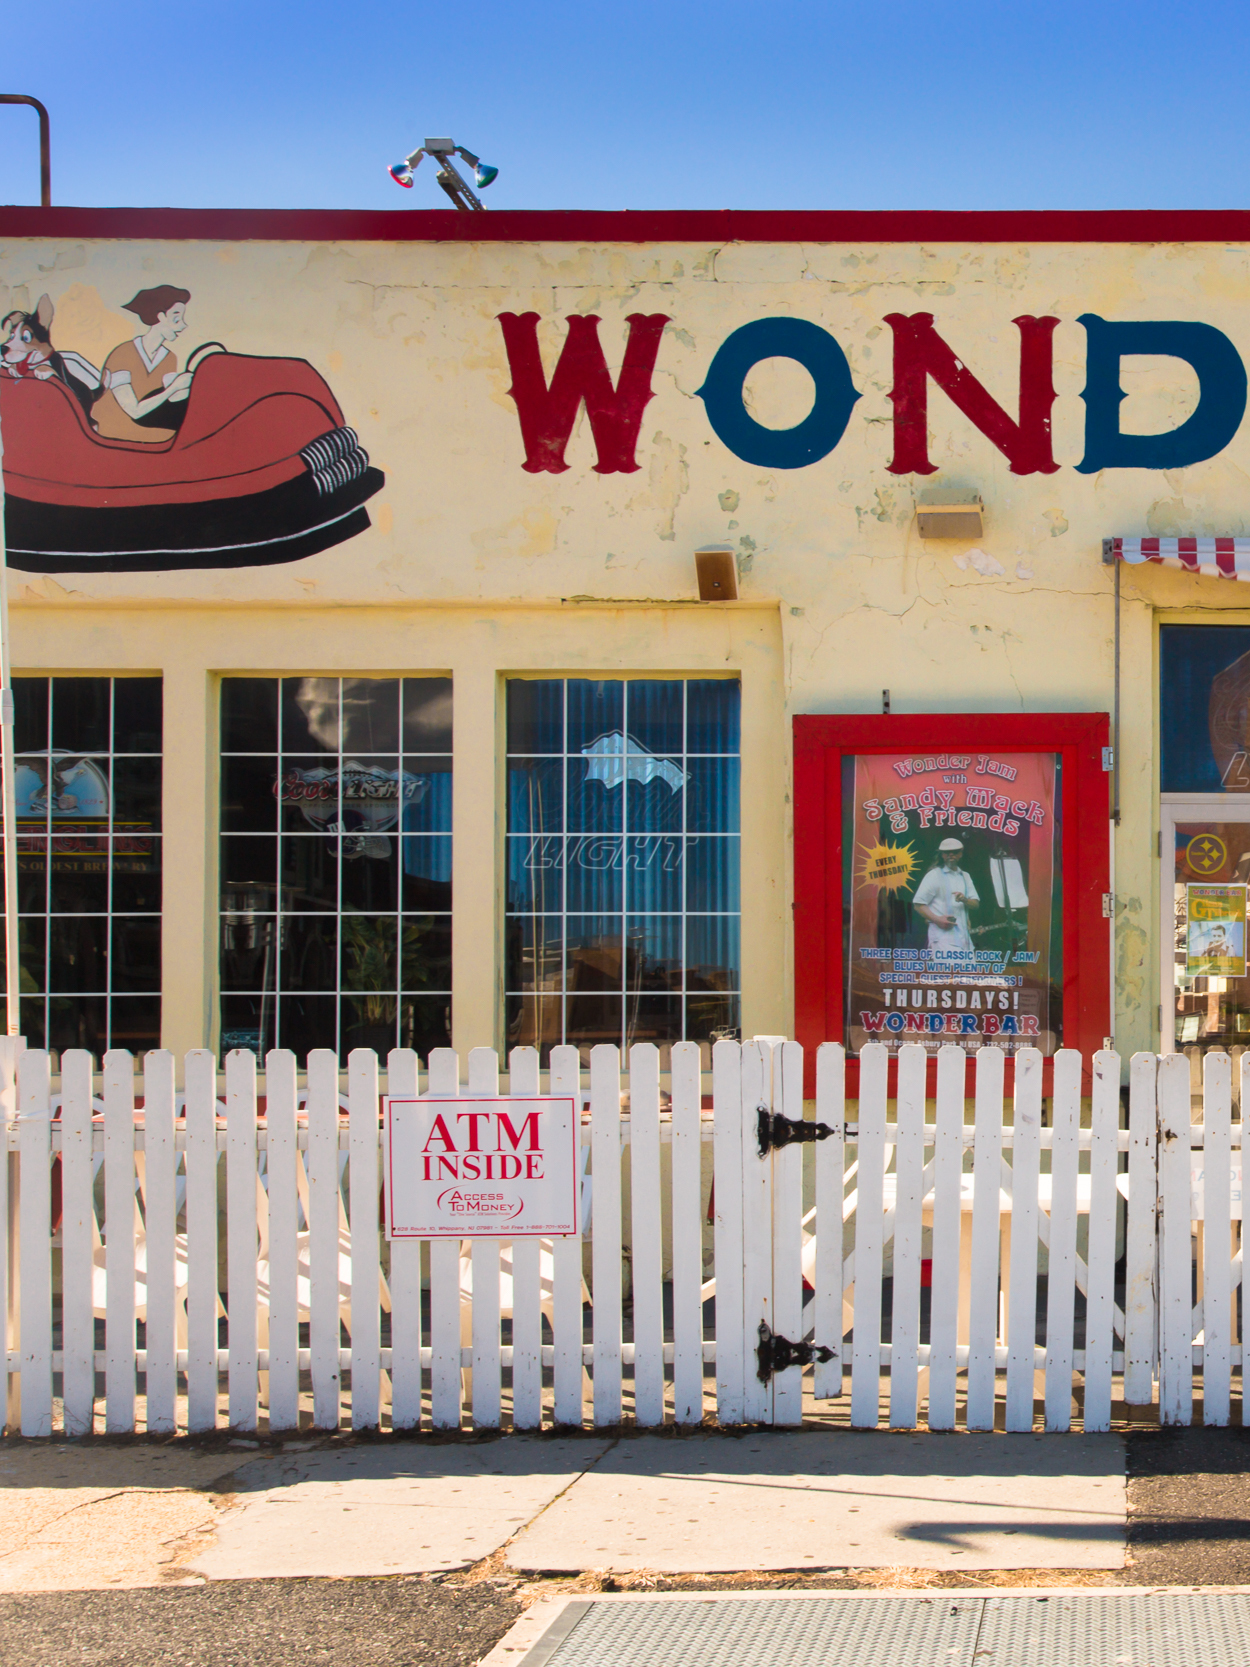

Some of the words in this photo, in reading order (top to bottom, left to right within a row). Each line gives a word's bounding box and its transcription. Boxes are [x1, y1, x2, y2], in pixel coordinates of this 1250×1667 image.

[893, 754, 971, 778] Wonder
[975, 755, 1017, 781] Jam
[943, 773, 968, 784] with
[271, 768, 342, 800] Coor
[863, 786, 954, 820] Sandy
[966, 786, 1045, 826] Mack
[889, 812, 909, 834] &
[918, 806, 1020, 836] Friends
[0, 826, 153, 853] ENGLING
[523, 834, 699, 871] LIGHT
[875, 855, 897, 867] EVERY
[868, 864, 909, 879] THURSDAY!
[859, 948, 892, 959] THREE
[893, 948, 918, 960] SETS
[920, 949, 933, 960] OF
[935, 950, 974, 961] CLASSIC
[975, 950, 1002, 962] ROCK
[879, 972, 918, 984] SPECIAL
[920, 973, 951, 984] GUEST
[894, 960, 924, 971] BLUES
[926, 962, 951, 972] WITH
[953, 962, 991, 973] PLENTY
[992, 963, 1006, 974] OF
[883, 988, 1019, 1010] THURSDAYS!
[860, 1011, 979, 1035] WONDER
[982, 1013, 1041, 1036] BAR
[968, 1040, 980, 1048] USA
[421, 1112, 545, 1152] ATM
[421, 1154, 545, 1181] INSIDE
[451, 1190, 504, 1201] ACCESS
